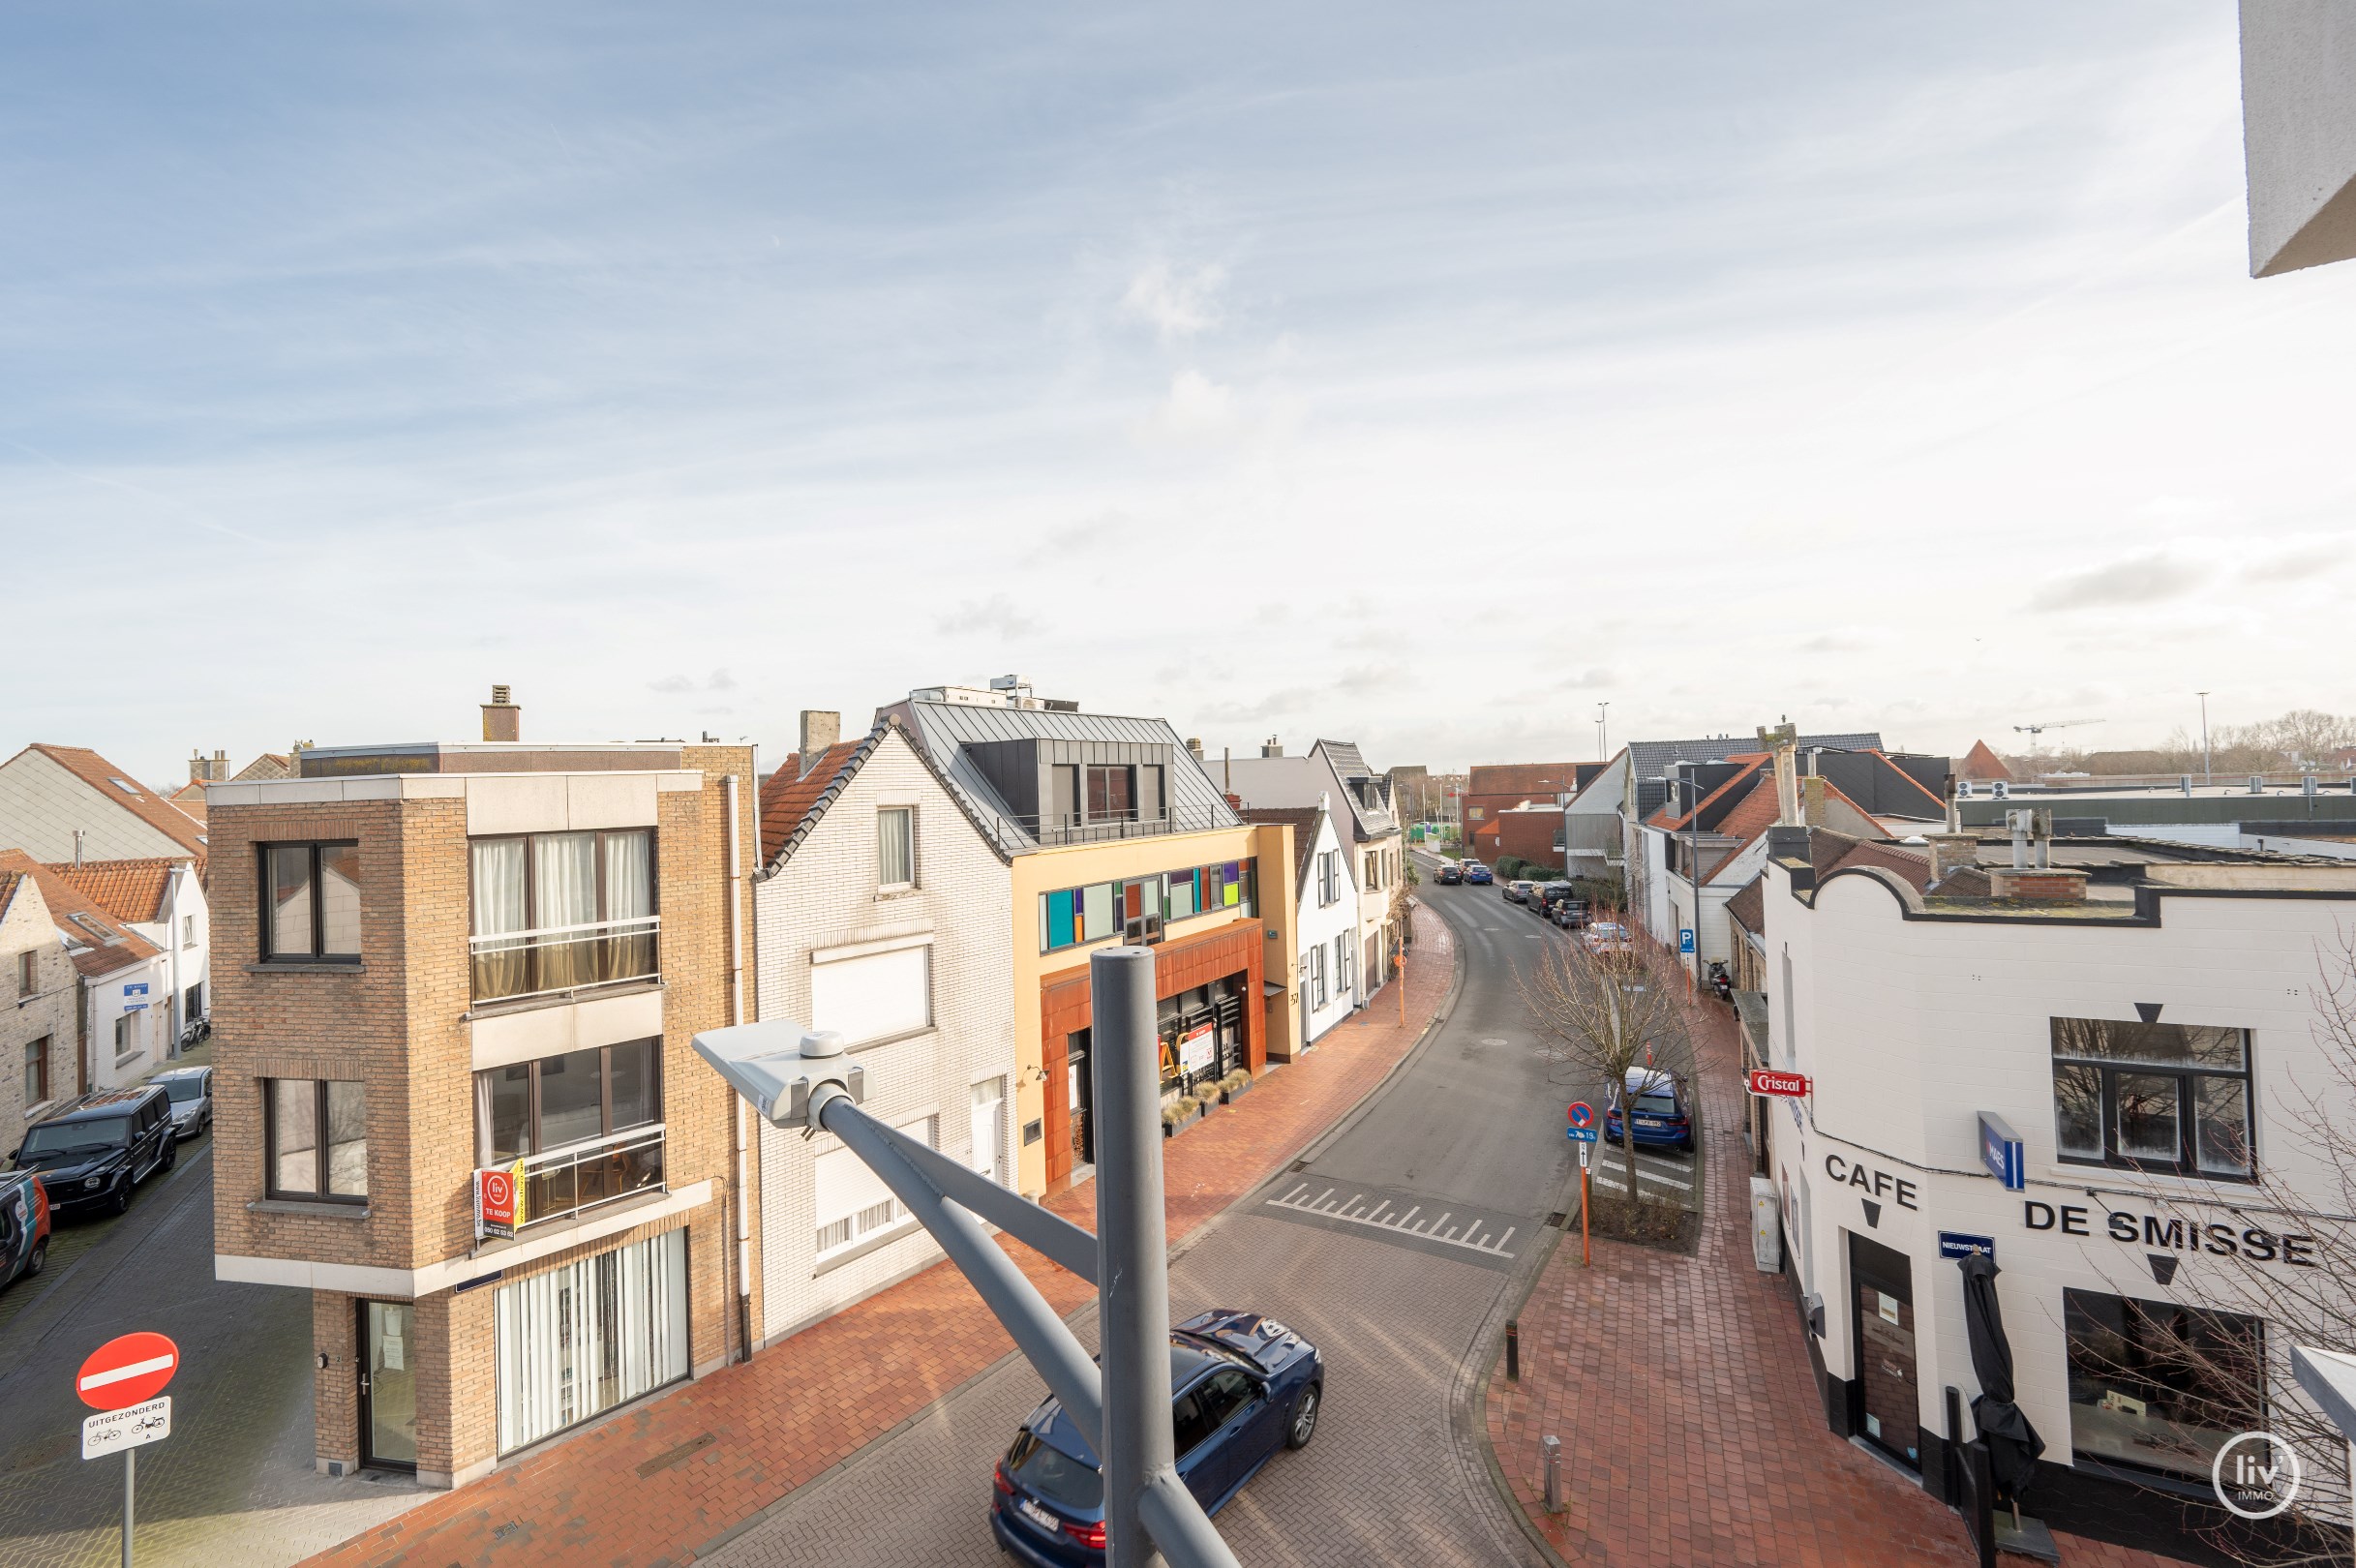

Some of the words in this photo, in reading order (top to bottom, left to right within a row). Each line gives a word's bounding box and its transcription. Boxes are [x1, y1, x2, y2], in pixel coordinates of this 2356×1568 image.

[1681, 931, 1692, 945] P
[1757, 1075, 1799, 1092] Cristal
[1988, 1142, 2005, 1170] MAES
[1825, 1154, 1918, 1211] CAFE
[494, 1209, 511, 1219] KOOP
[2024, 1200, 2090, 1236] DE
[2107, 1211, 2315, 1267] SMISSE
[1942, 1241, 1992, 1254] NIEUWSTAAT
[88, 1402, 165, 1429] UITGEZONDERD
